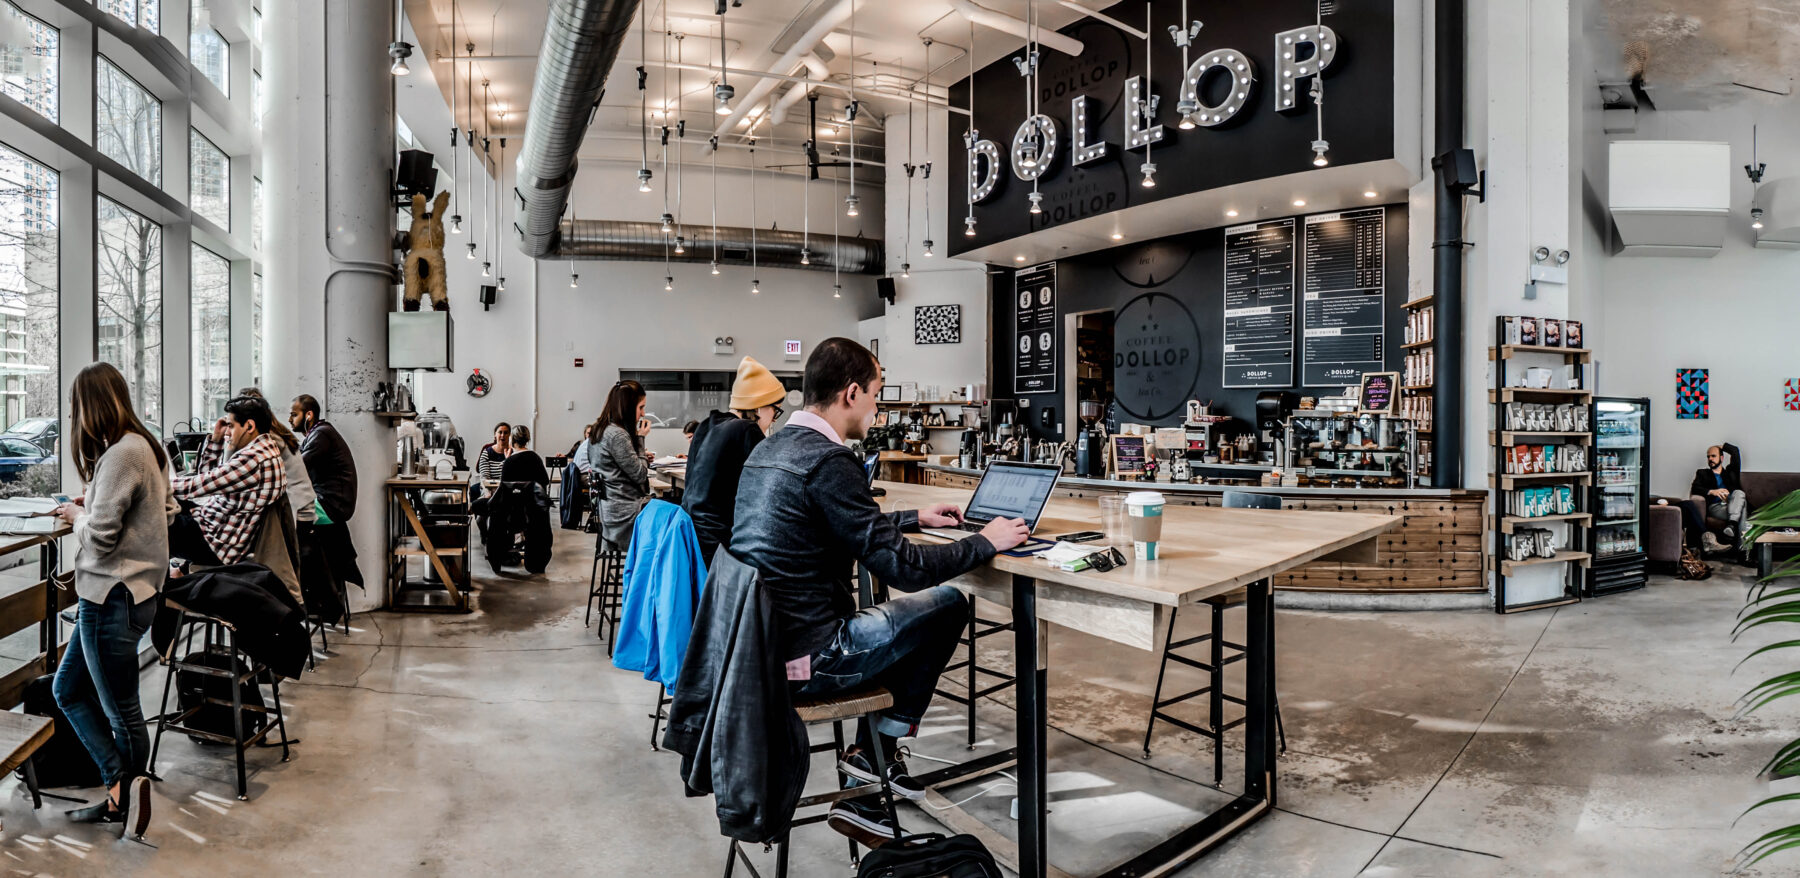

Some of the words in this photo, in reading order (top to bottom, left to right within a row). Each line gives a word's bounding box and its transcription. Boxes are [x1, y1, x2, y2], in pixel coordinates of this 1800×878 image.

[1042, 60, 1118, 104] DOLLOP
[968, 25, 1337, 205] DOLLOP
[1041, 192, 1117, 226] DOLLOP
[787, 342, 799, 352] EXIT
[1126, 336, 1174, 347] COFFEE
[1115, 348, 1189, 368] DOLLOP
